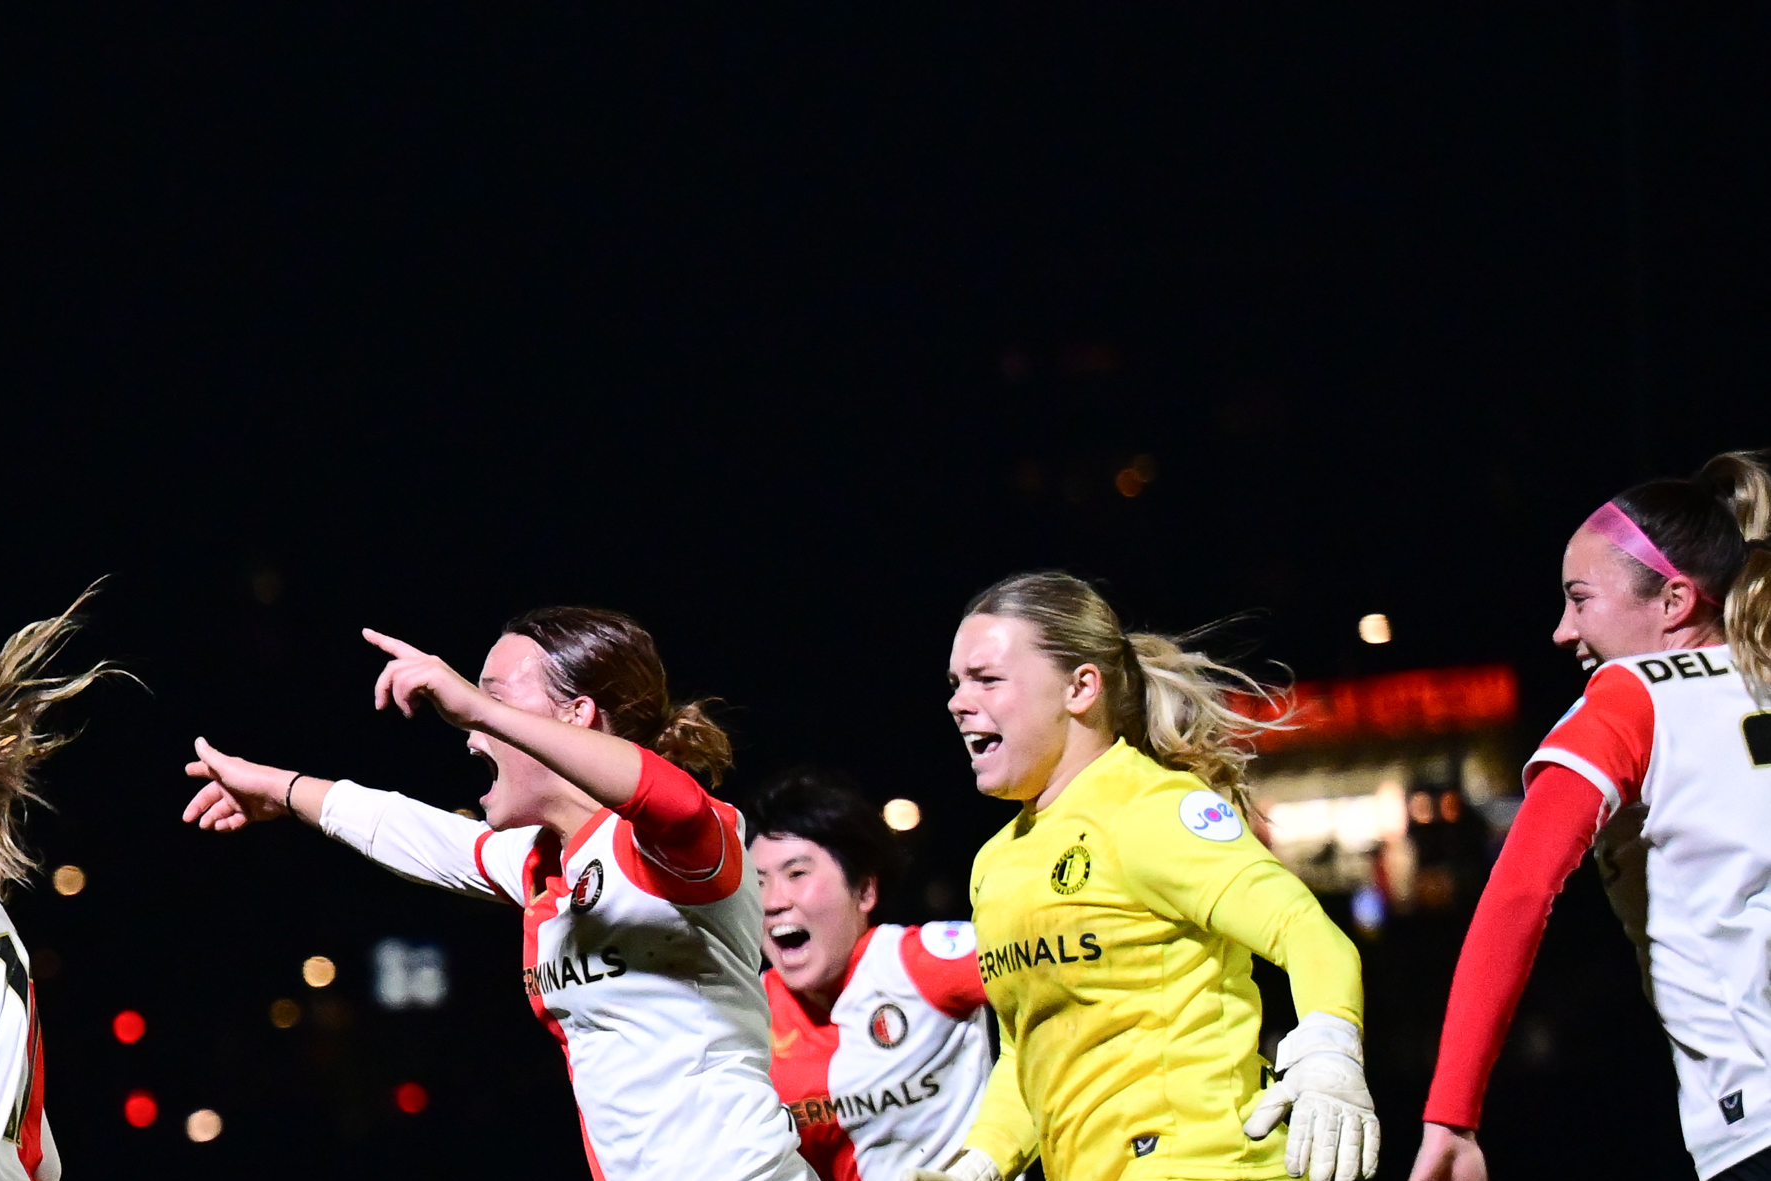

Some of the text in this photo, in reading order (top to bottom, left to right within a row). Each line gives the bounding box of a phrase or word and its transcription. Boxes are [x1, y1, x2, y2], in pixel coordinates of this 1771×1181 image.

[1636, 650, 1738, 685] DEL
[978, 932, 1103, 984] ERMINALS
[788, 1073, 941, 1128] ERMINALS
